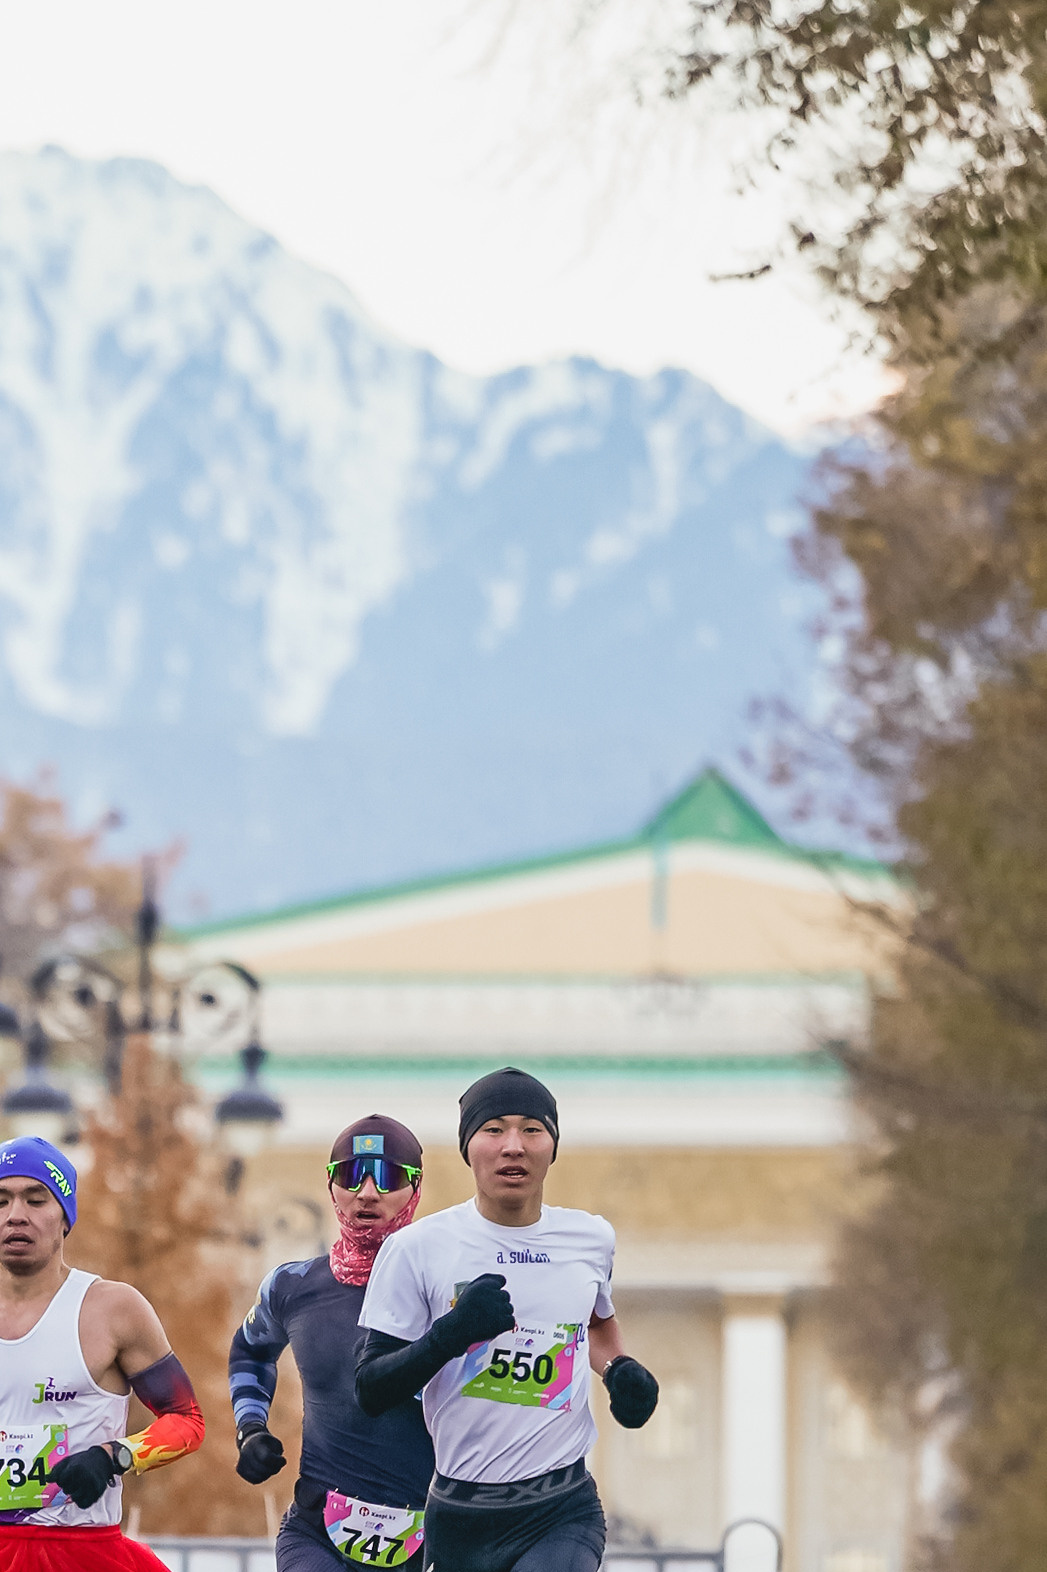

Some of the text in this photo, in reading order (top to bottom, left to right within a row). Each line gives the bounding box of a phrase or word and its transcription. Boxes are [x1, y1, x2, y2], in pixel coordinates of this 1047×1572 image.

[520, 1327, 545, 1335] Kaspi.kz
[489, 1348, 553, 1385] 550
[9, 1433, 34, 1441] Kaspi.kz
[470, 1465, 575, 1503] 2XU
[371, 1511, 396, 1521] Kaspi.kz
[342, 1526, 405, 1565] 747
